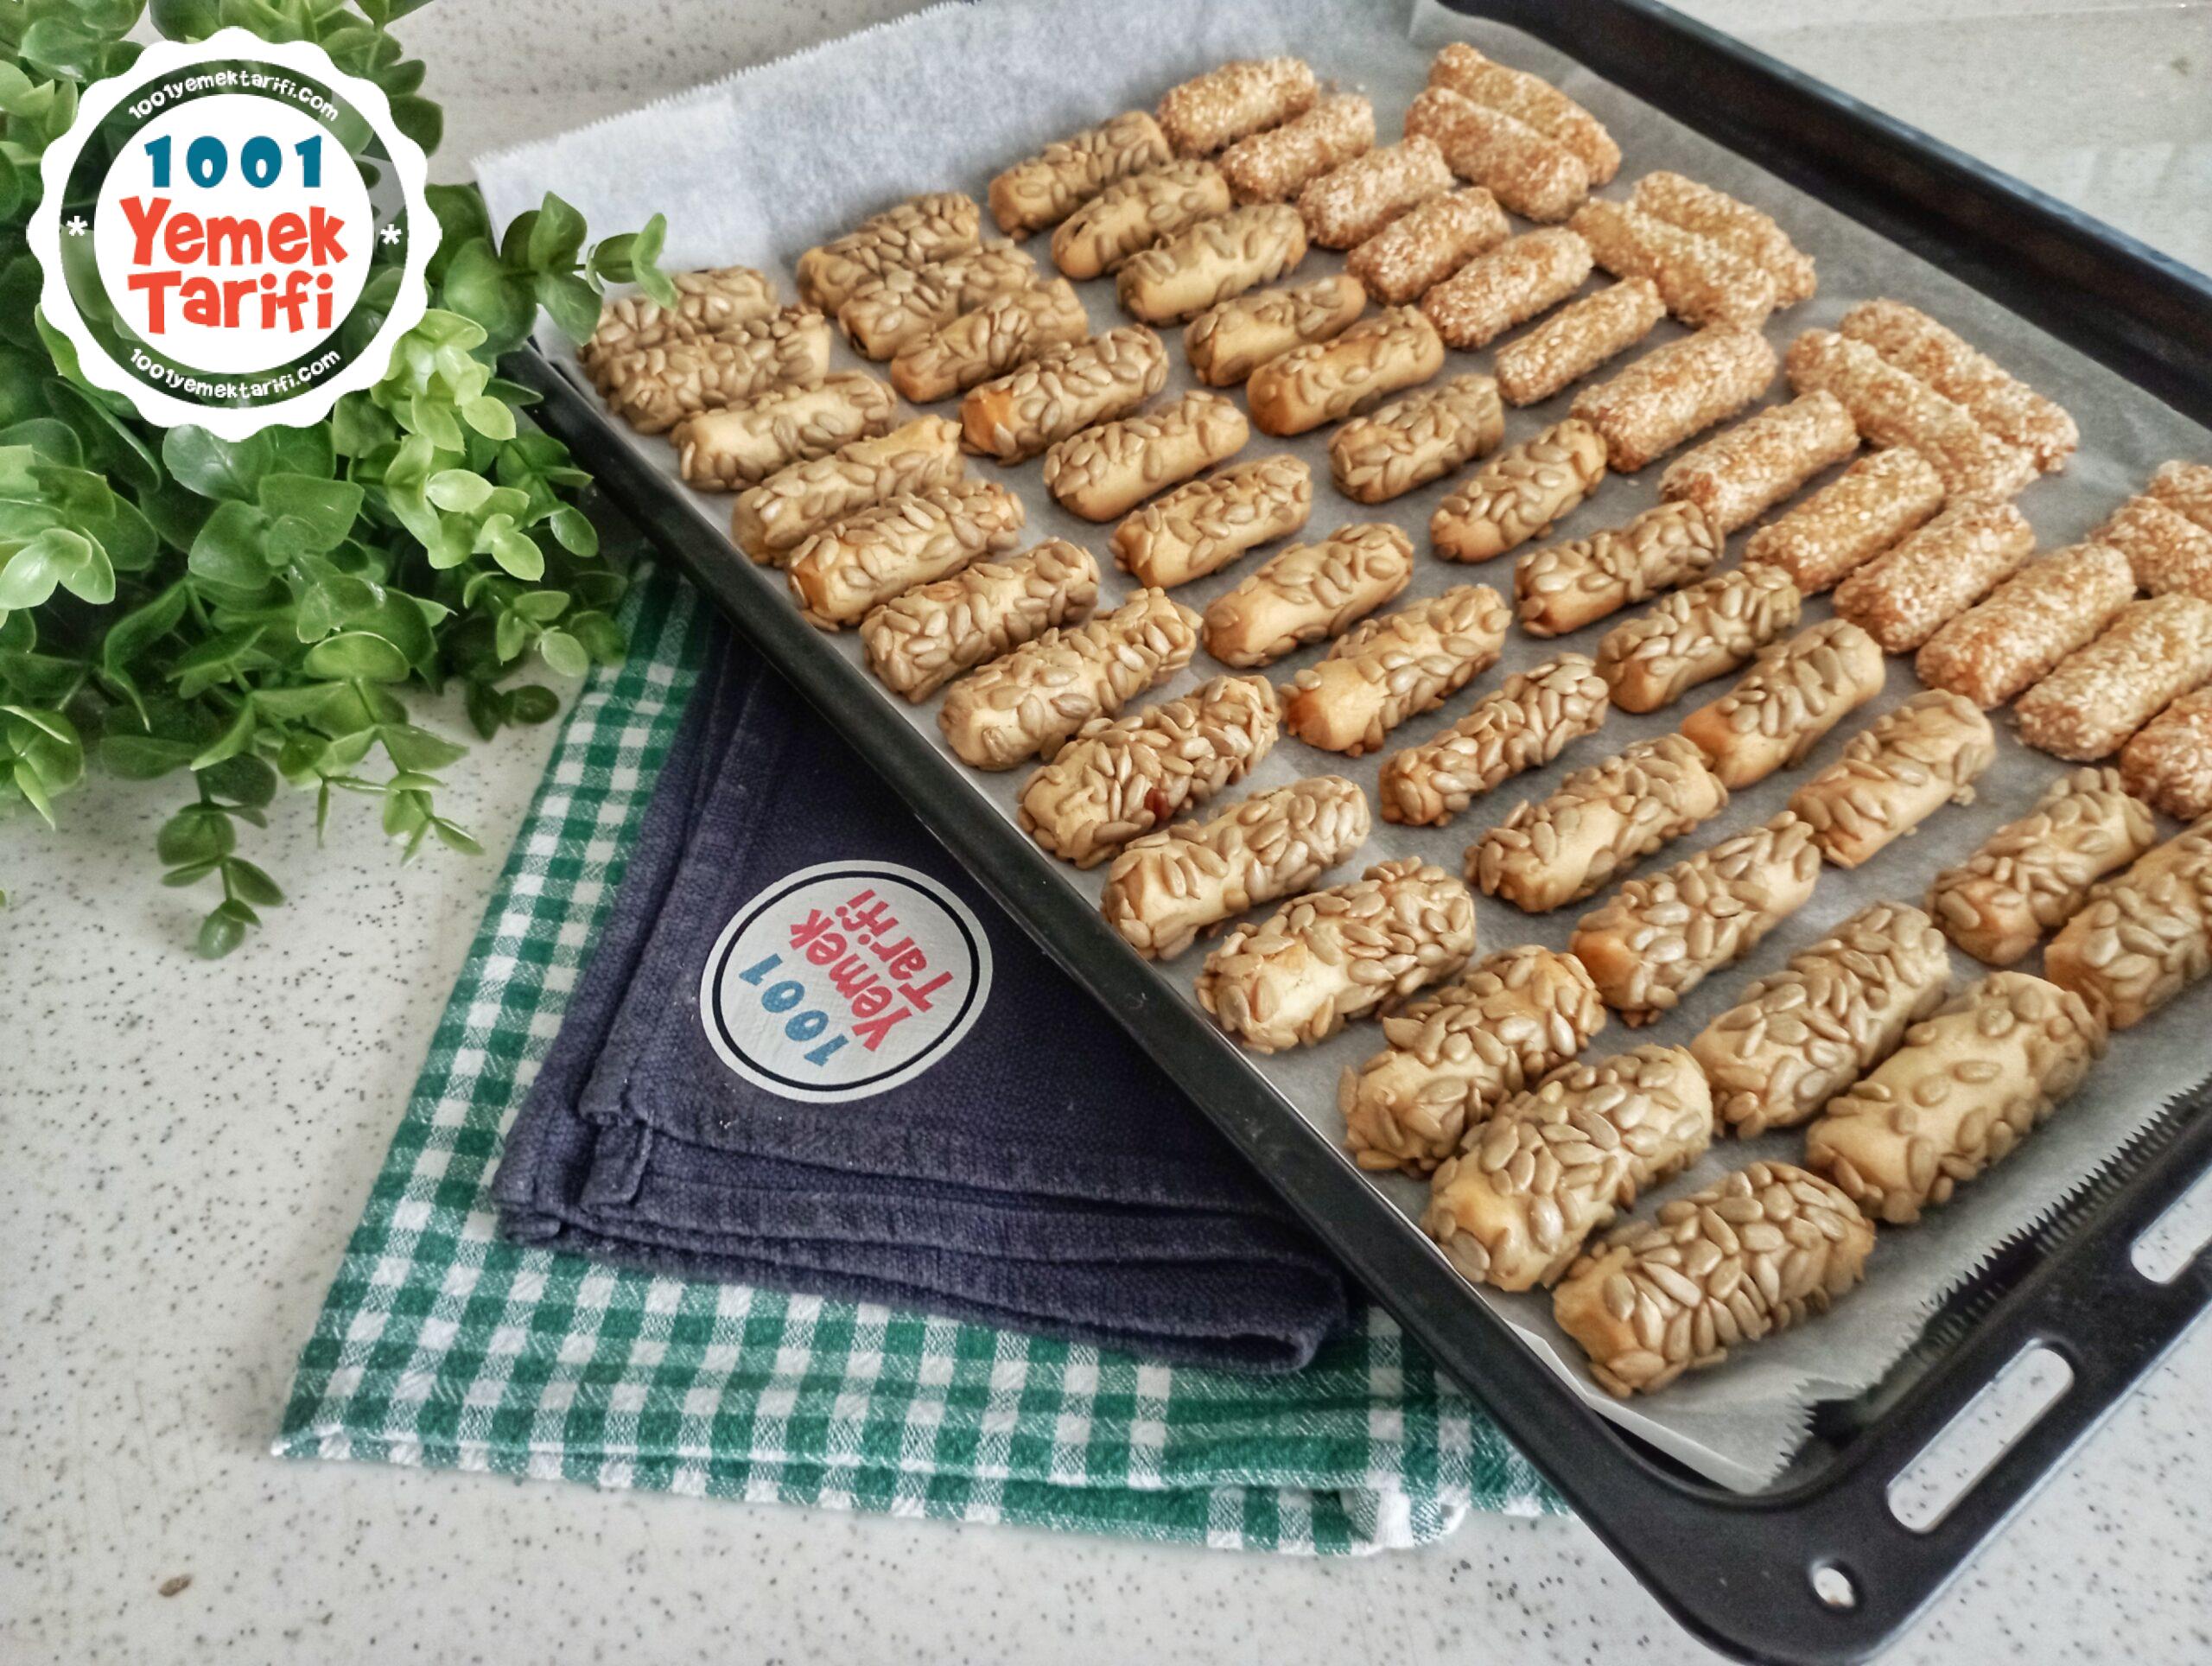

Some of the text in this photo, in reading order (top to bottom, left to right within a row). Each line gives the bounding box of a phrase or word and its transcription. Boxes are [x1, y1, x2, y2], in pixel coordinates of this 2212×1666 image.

[739, 953, 849, 1066] 1001
[789, 909, 912, 1052] Yemek
[835, 889, 954, 1012] Tarifi
